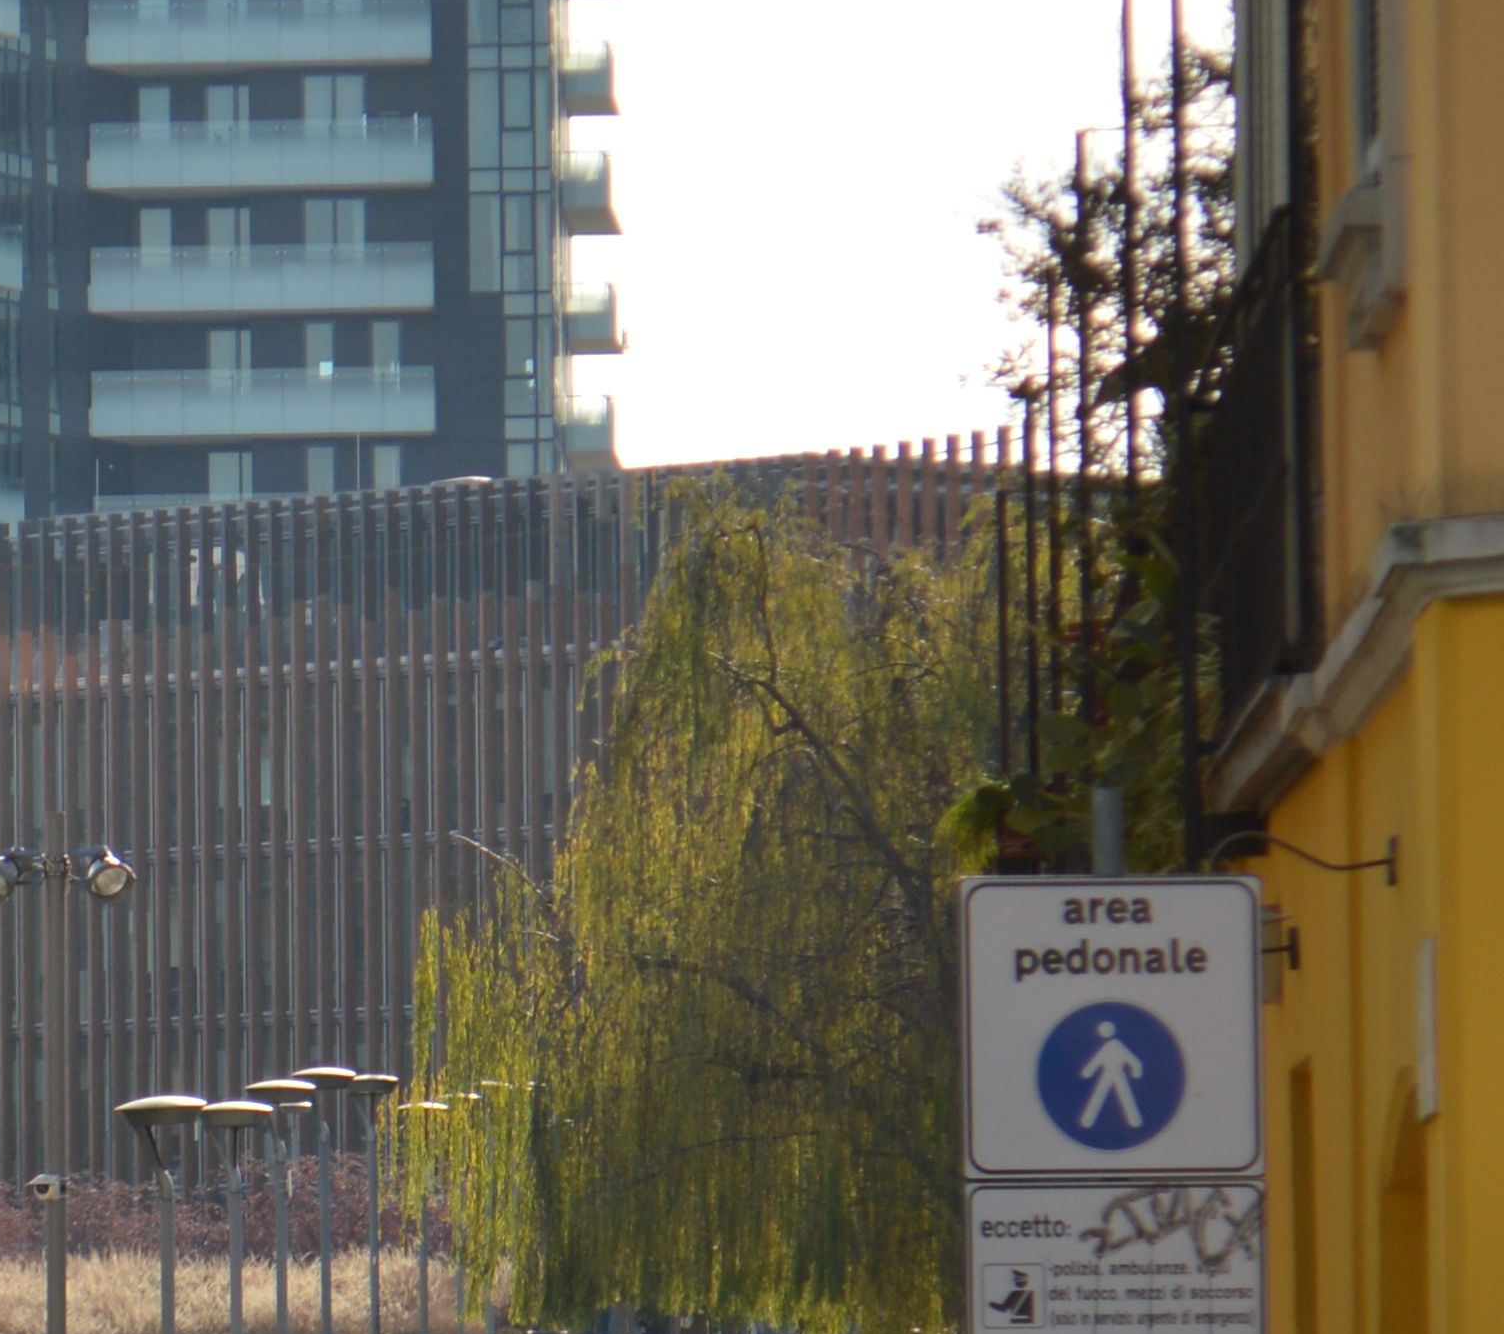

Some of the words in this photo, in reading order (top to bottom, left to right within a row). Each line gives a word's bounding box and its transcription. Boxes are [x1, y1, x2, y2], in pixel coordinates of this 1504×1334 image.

[1063, 897, 1152, 924] area
[1015, 938, 1208, 982] pedonale
[980, 1214, 1072, 1238] eccetto:
[1049, 1286, 1072, 1301] del
[1125, 1285, 1166, 1300] mezzi
[1171, 1284, 1185, 1300] di
[1189, 1287, 1253, 1300] soccorso
